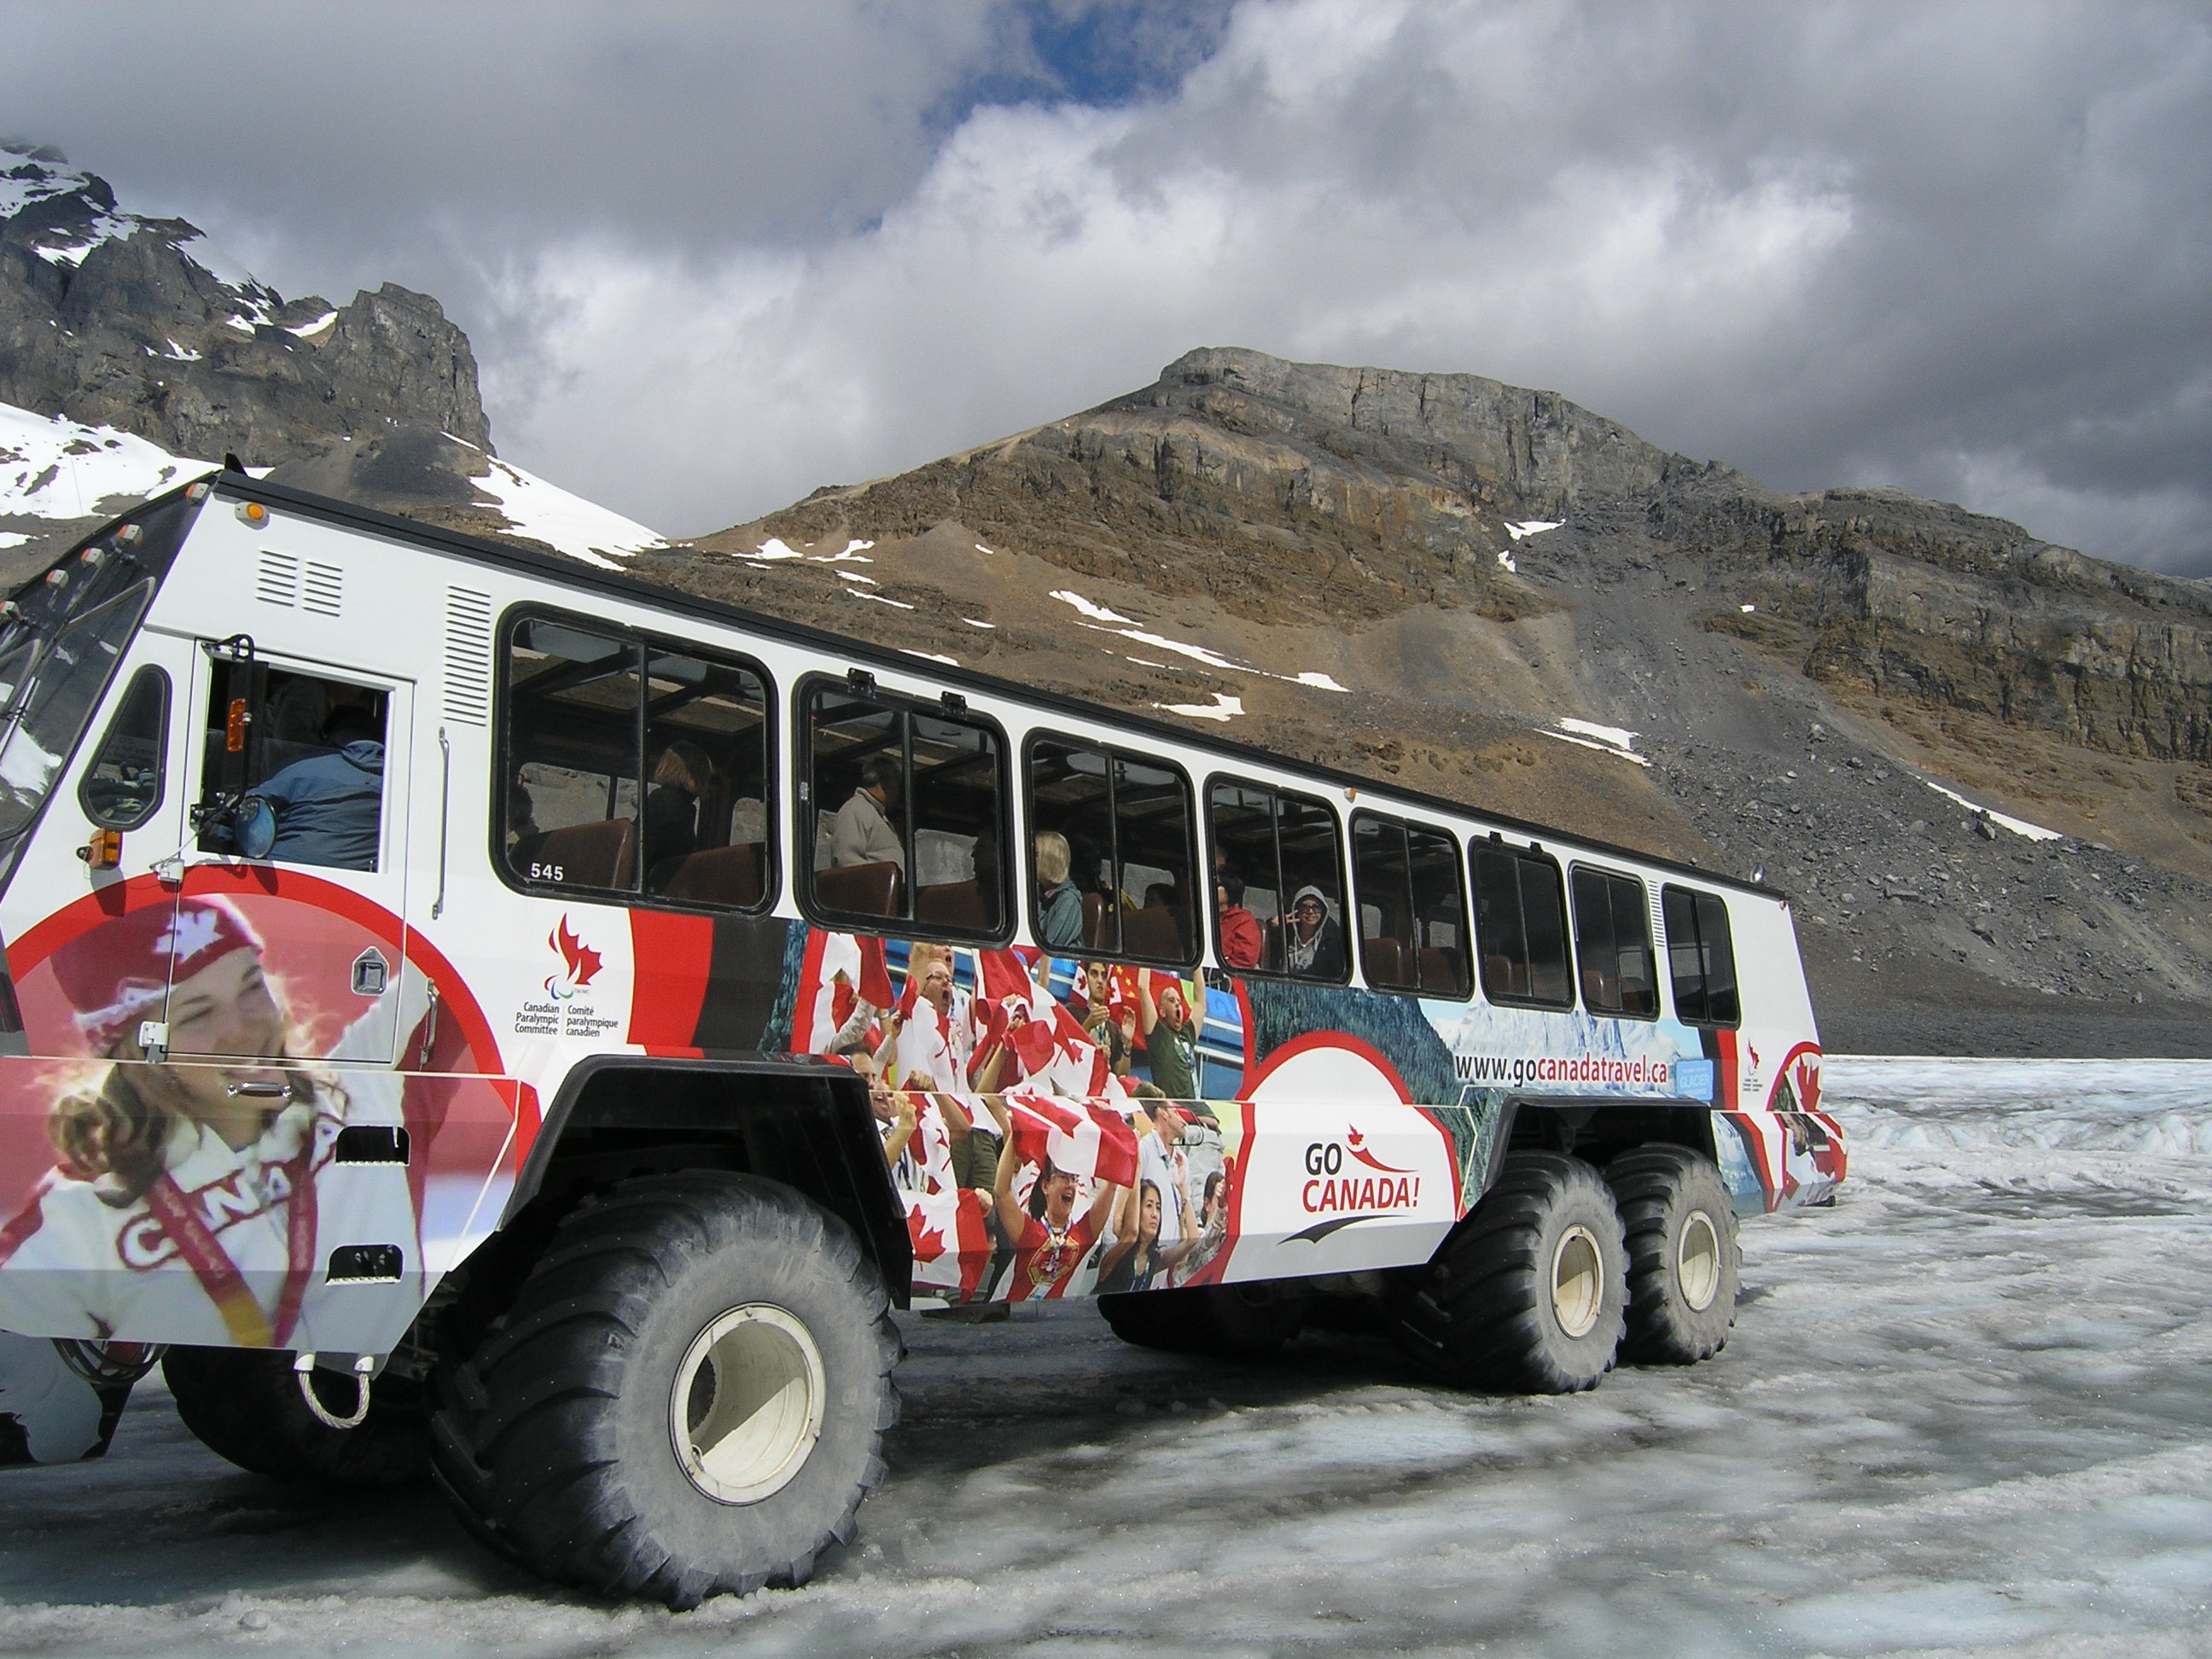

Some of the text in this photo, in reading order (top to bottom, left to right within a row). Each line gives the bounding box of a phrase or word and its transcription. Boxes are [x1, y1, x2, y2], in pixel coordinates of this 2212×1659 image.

[530, 862, 564, 882] 545
[523, 1001, 560, 1014] Canadian
[568, 1004, 595, 1016] Comité
[515, 1012, 560, 1026] Paralympic
[566, 1016, 619, 1030] paralympique
[514, 1022, 559, 1035] Committee
[566, 1027, 601, 1038] canadien
[1454, 1051, 1668, 1087] www.gocanadatravel.ca
[1305, 1142, 1342, 1176] GO
[1301, 1176, 1421, 1214] CANADA!
